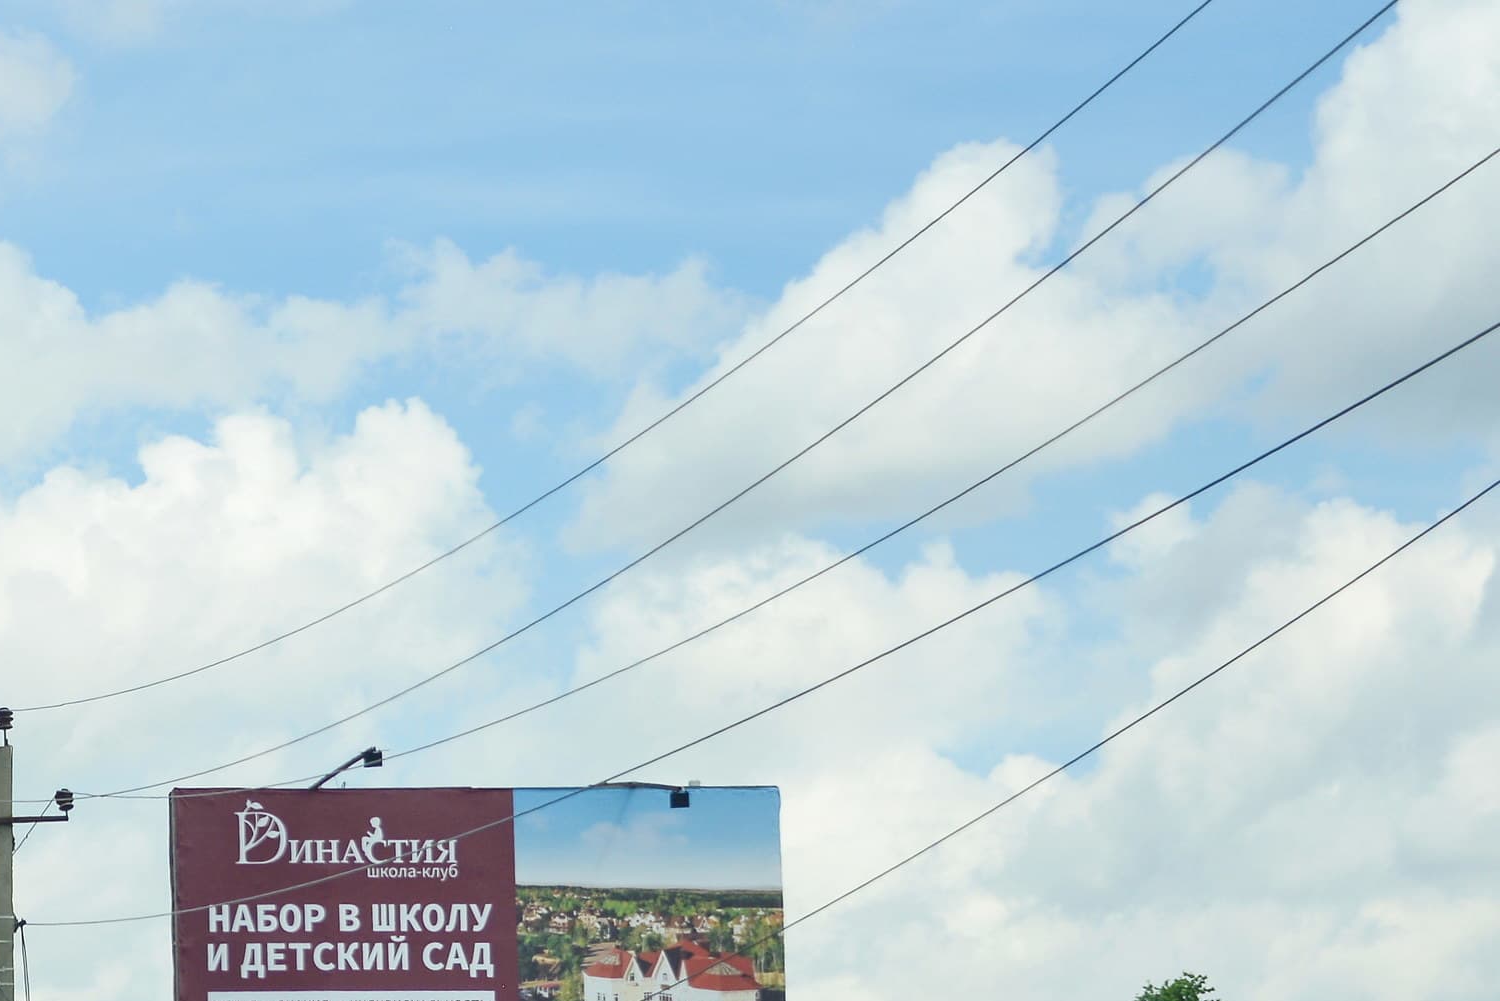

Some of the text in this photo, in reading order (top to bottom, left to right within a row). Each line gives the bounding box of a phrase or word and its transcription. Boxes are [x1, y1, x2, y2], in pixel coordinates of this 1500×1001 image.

[367, 866, 458, 881] школа-клуб
[208, 903, 492, 932] НАБОР В ШКОЛУ
[207, 935, 495, 979] И ДЕТСКИЙ САД
